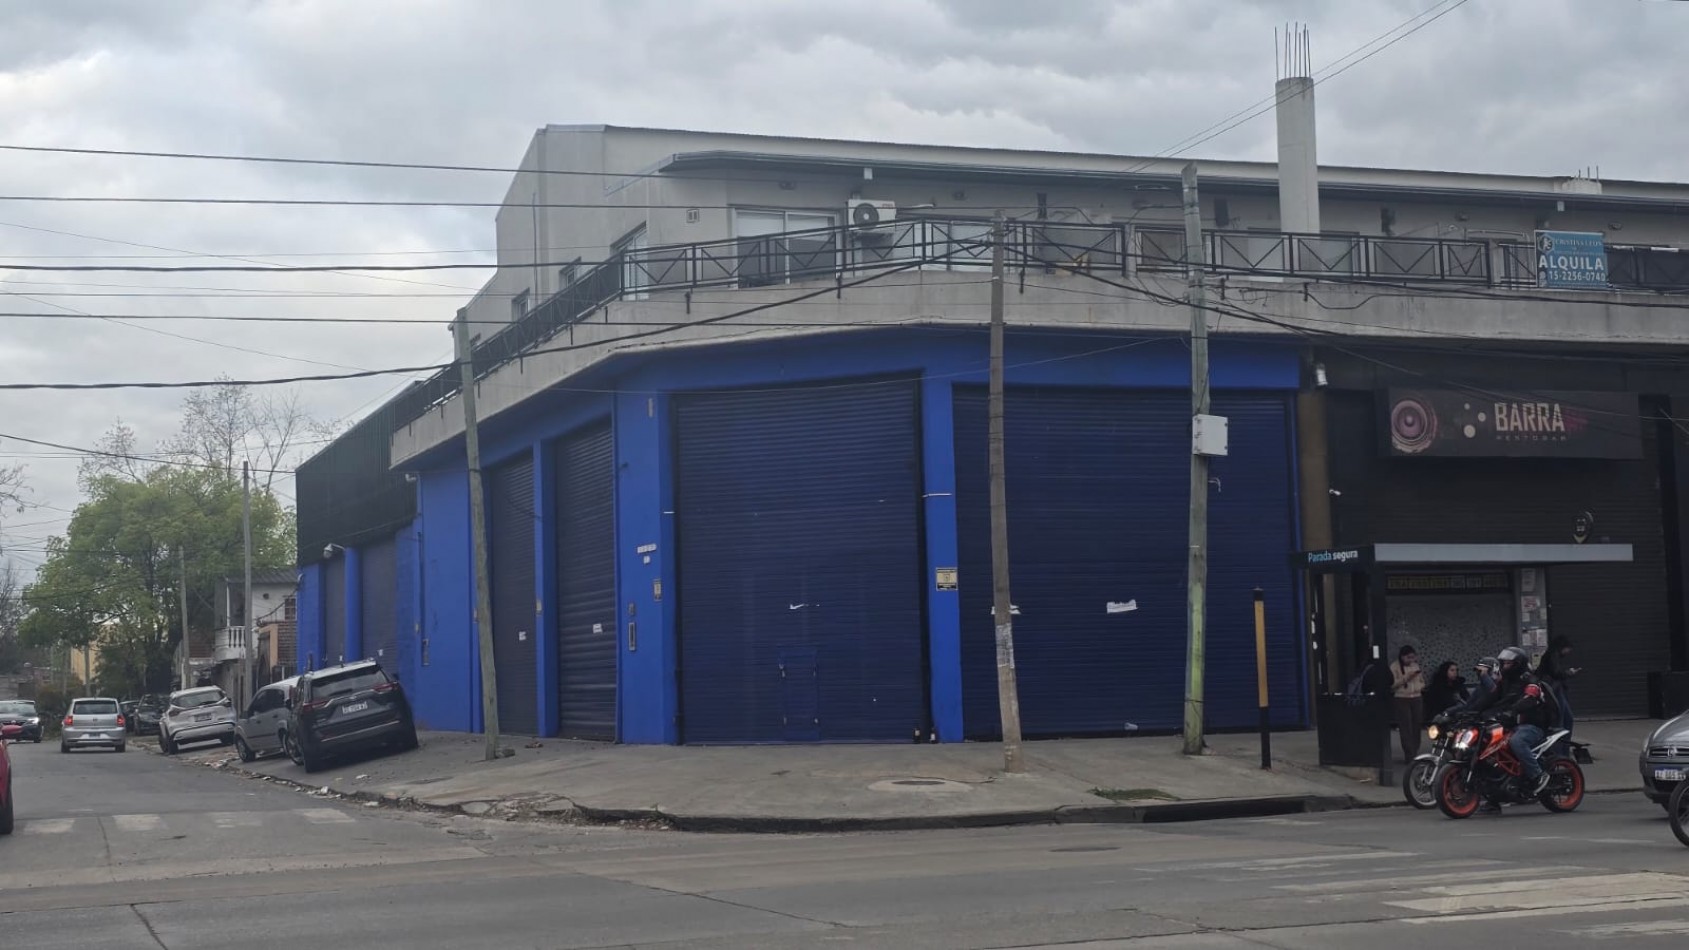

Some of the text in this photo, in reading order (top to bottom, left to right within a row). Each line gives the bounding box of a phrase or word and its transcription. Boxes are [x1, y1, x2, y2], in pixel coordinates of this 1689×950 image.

[1539, 255, 1604, 270] ALQUILA
[1494, 402, 1566, 432] BARRA
[1308, 550, 1358, 562] Parada segura
